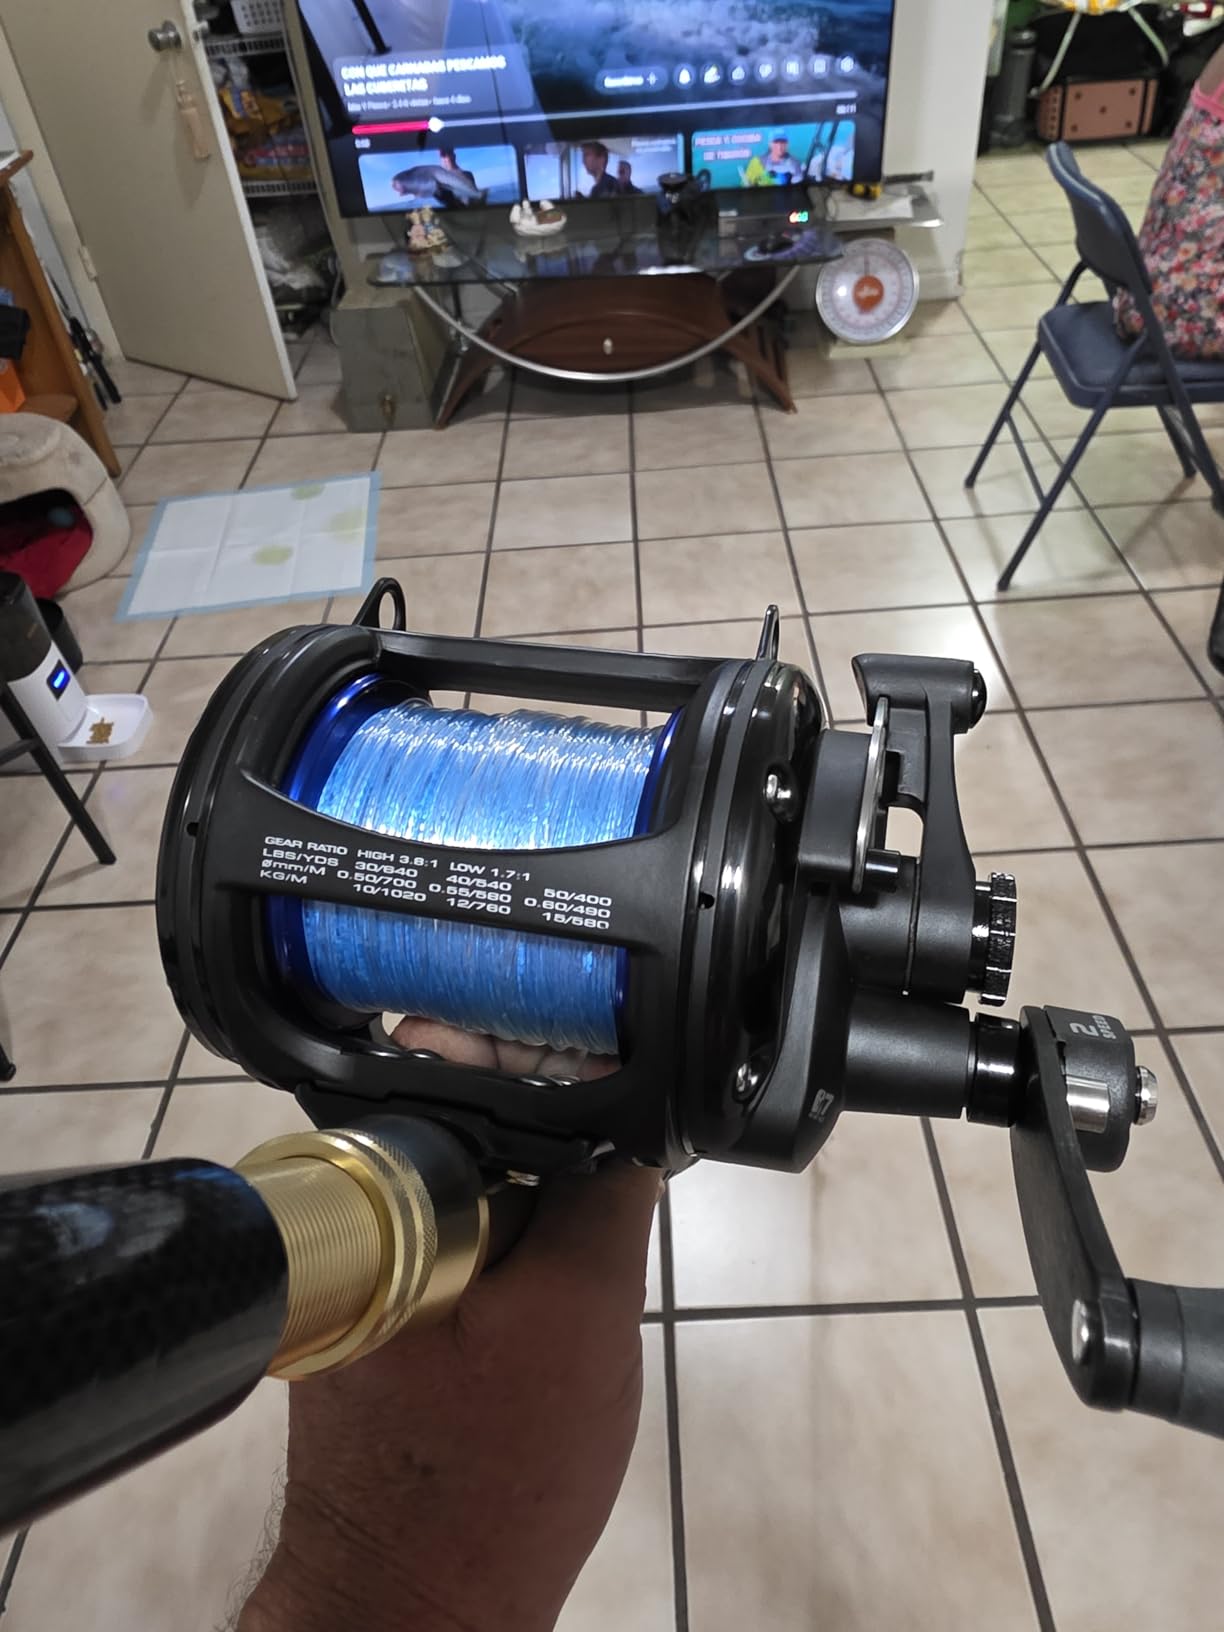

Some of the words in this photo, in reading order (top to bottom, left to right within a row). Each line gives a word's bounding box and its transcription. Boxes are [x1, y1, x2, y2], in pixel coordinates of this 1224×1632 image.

[262, 848, 339, 867] LBS/YDS
[544, 888, 612, 907] 50/400
[264, 836, 303, 849] GEAR
[307, 841, 348, 856] RATIO
[357, 849, 395, 862] HIGH
[449, 861, 486, 875] LOW
[490, 867, 530, 881] 1.7:1
[260, 869, 308, 884] KG/M
[353, 883, 427, 902] 10/1020
[1069, 1022, 1099, 1037] 2
